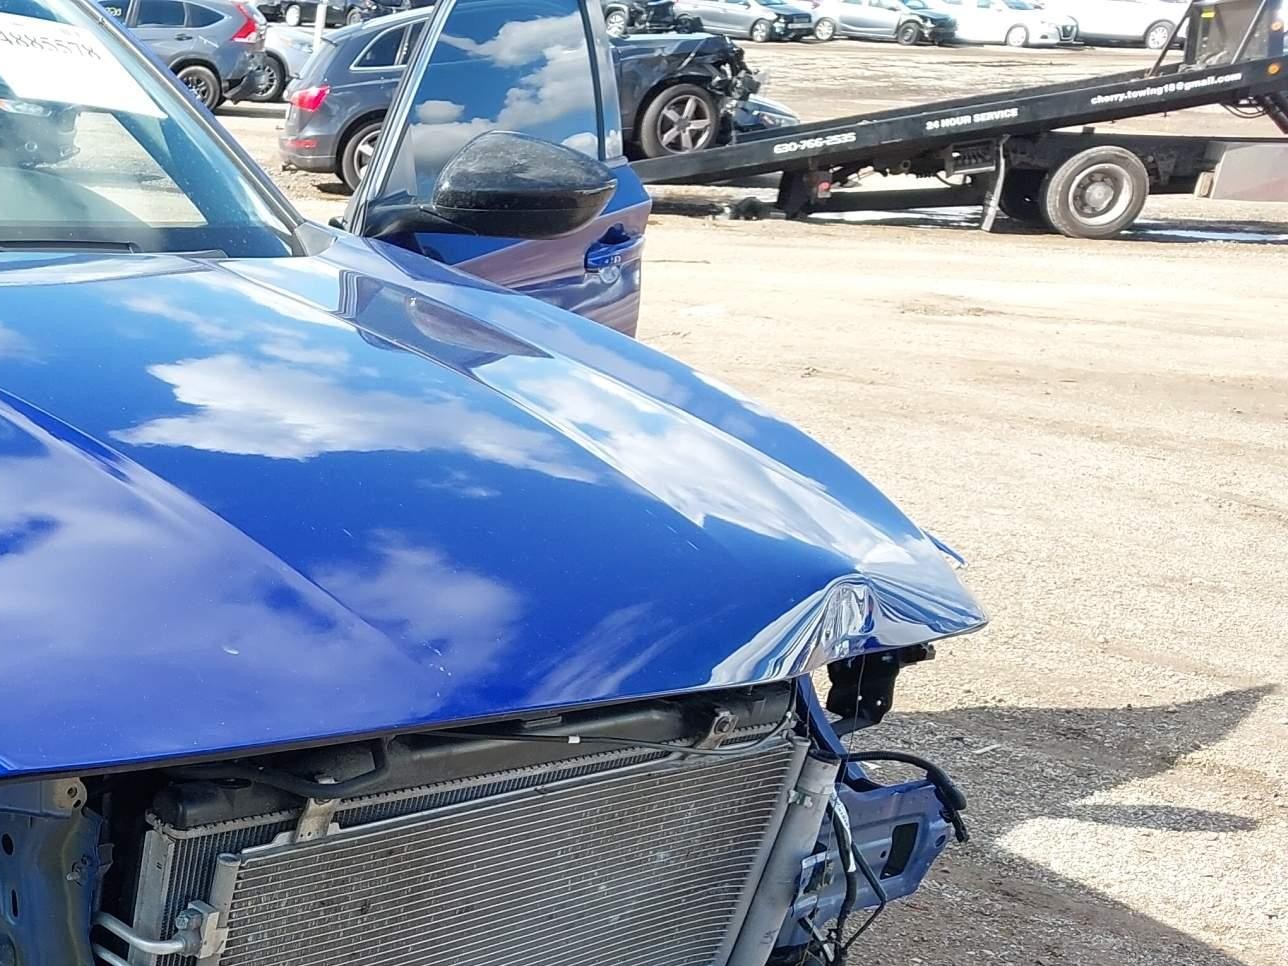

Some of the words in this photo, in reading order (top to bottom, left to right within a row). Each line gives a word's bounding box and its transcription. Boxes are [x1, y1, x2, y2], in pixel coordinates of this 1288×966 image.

[925, 119, 940, 130] 24
[940, 115, 972, 128] HOUR
[972, 107, 1019, 123] SERVICE
